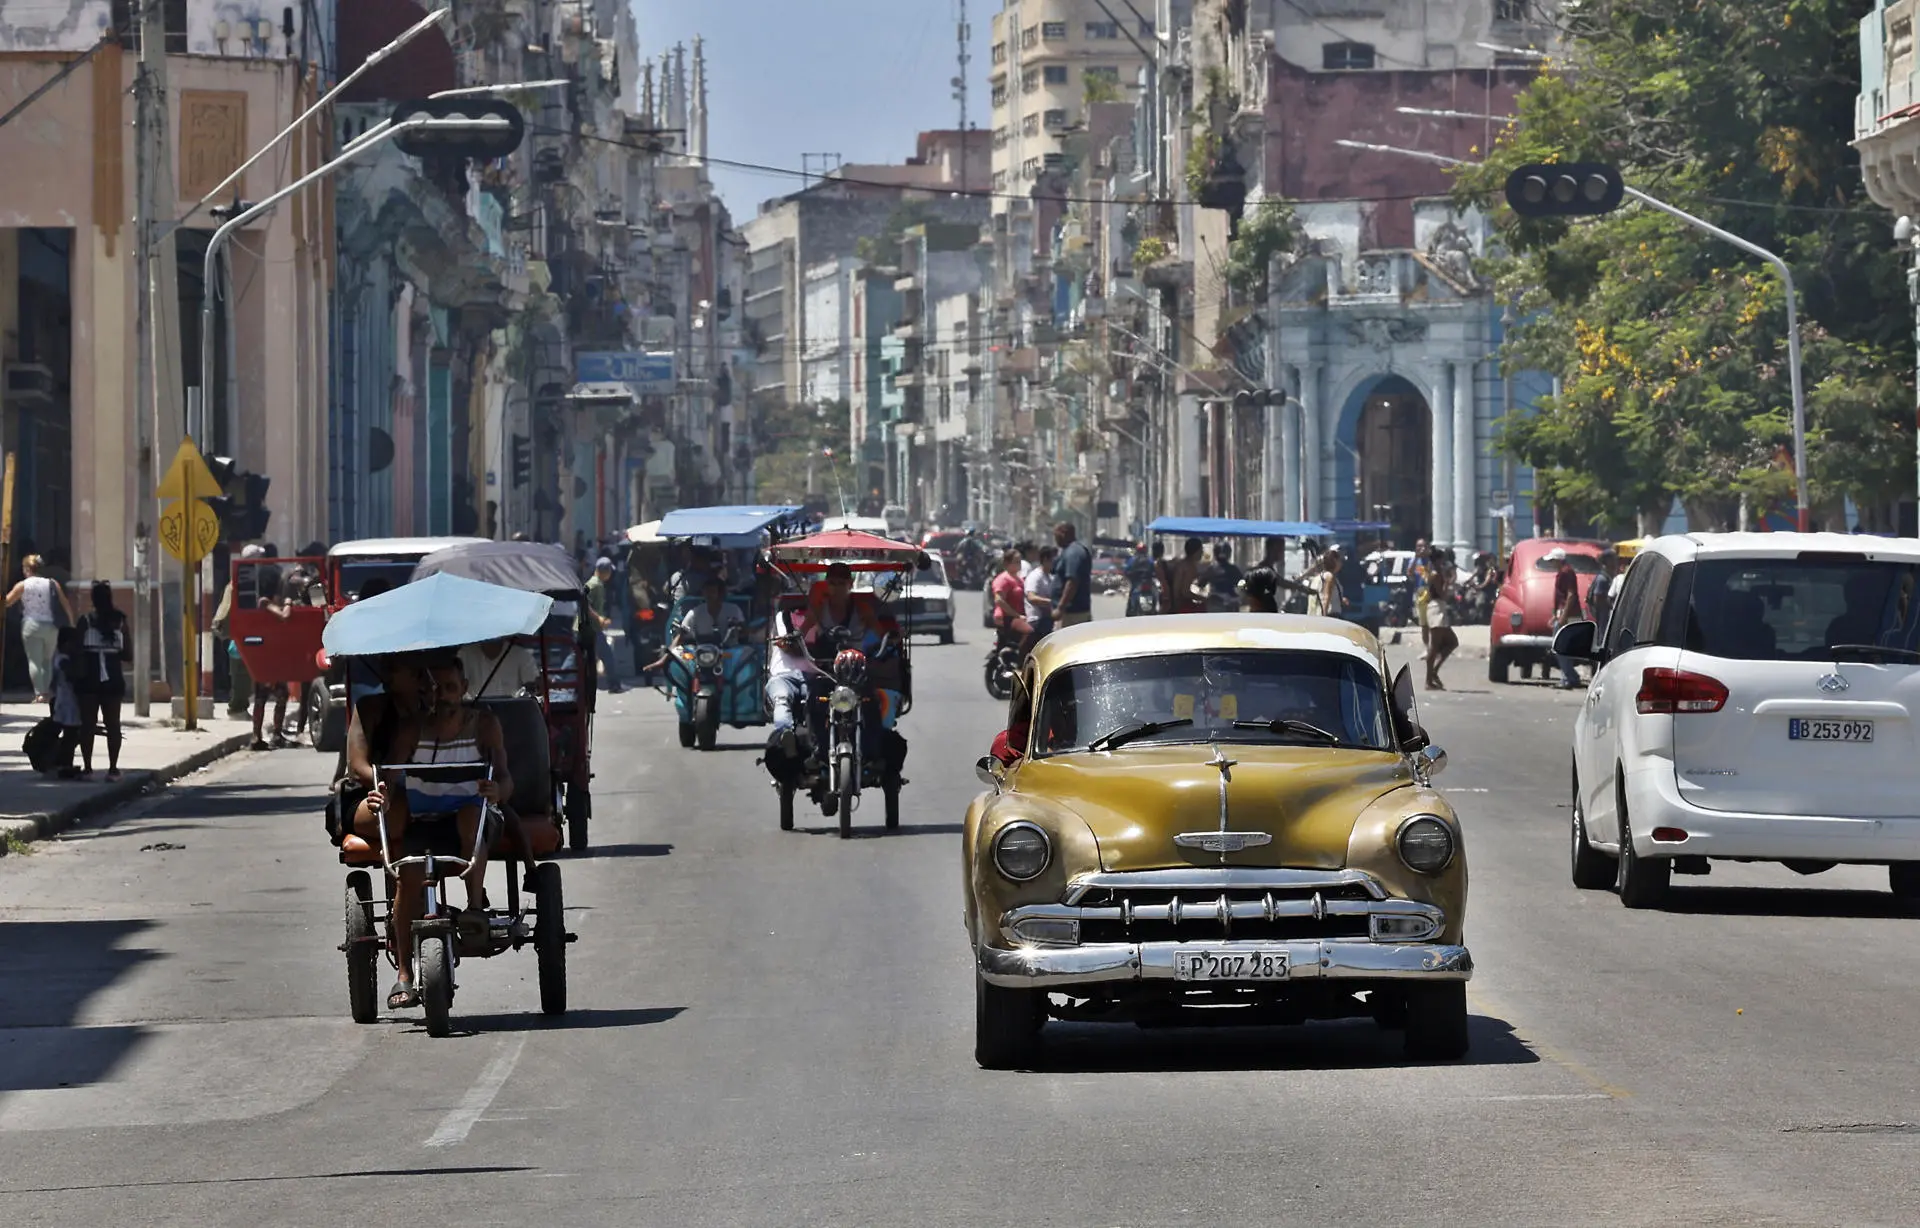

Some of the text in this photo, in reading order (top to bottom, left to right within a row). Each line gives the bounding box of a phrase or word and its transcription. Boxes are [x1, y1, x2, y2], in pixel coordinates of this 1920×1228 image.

[1800, 721, 1810, 738] B
[1813, 722, 1841, 739] 253
[1843, 723, 1871, 740] 992
[1190, 956, 1287, 978] P 207 283
